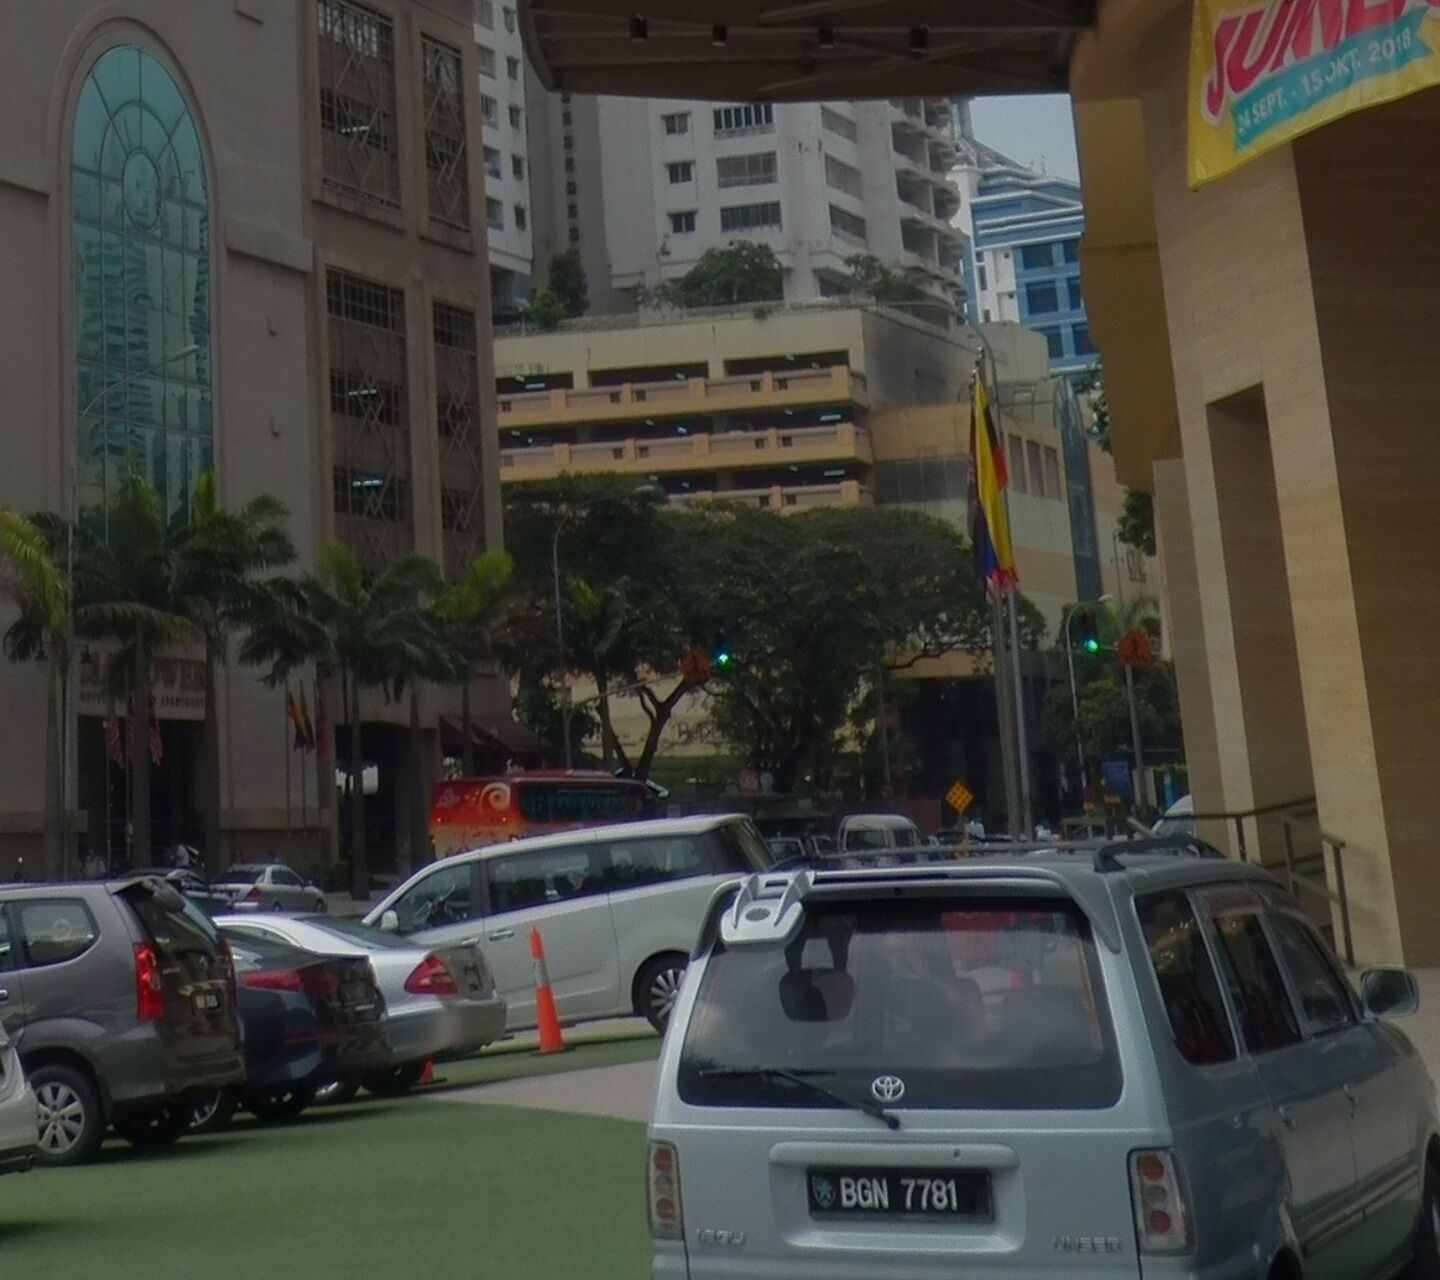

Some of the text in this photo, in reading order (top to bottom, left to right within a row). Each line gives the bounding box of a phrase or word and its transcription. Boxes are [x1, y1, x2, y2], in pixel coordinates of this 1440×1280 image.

[1367, 27, 1412, 63] 2018
[839, 1176, 958, 1211] BGN 7781
